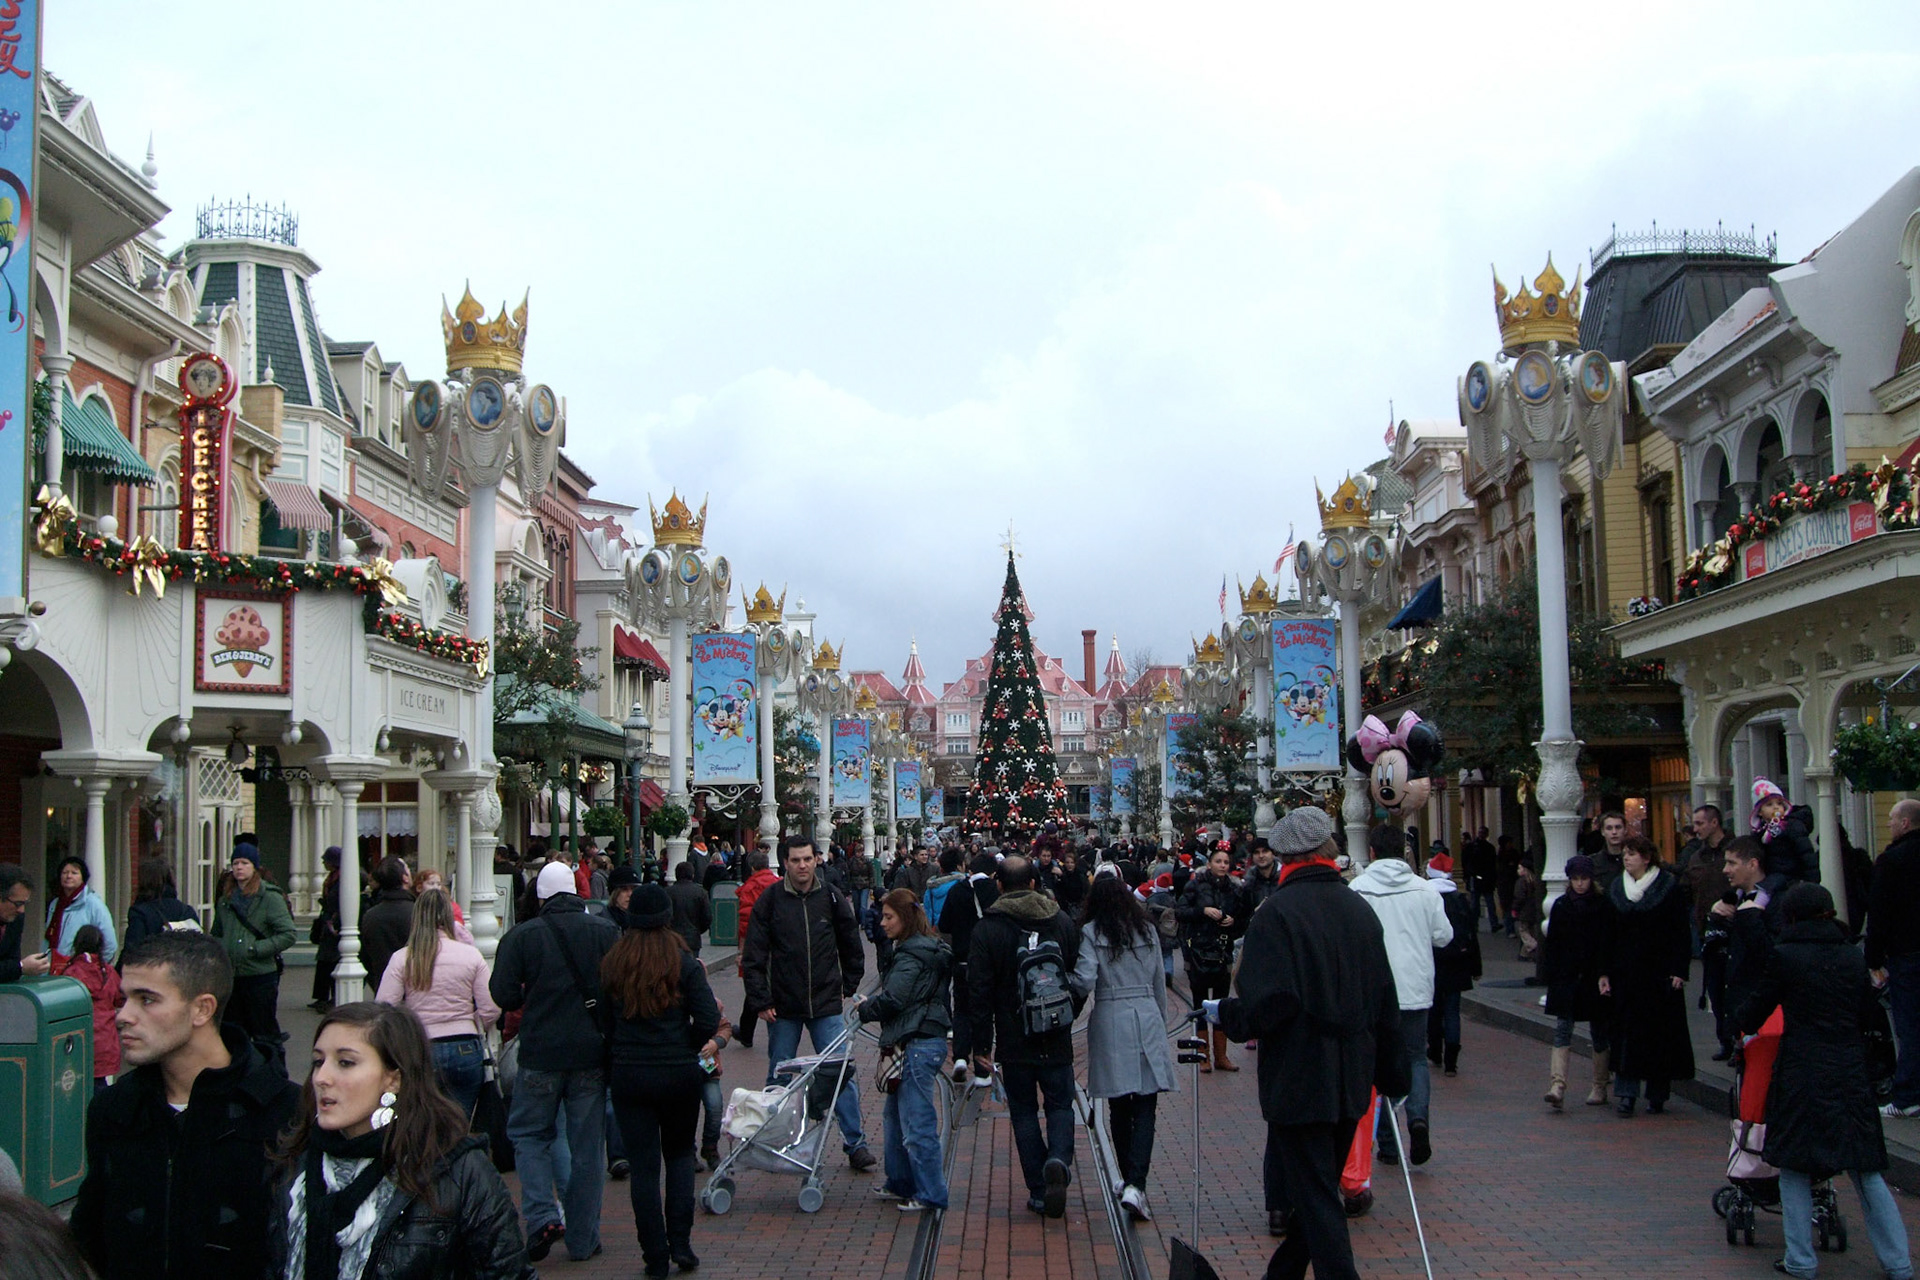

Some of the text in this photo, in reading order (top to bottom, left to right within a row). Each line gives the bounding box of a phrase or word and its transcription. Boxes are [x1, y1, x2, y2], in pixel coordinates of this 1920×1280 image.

[192, 410, 209, 466] ICE
[190, 471, 210, 549] CREA
[1805, 508, 1850, 546] CORNER
[213, 651, 233, 664] BEN
[239, 650, 271, 667] JERRY'S
[400, 689, 445, 715] ICE CREAM
